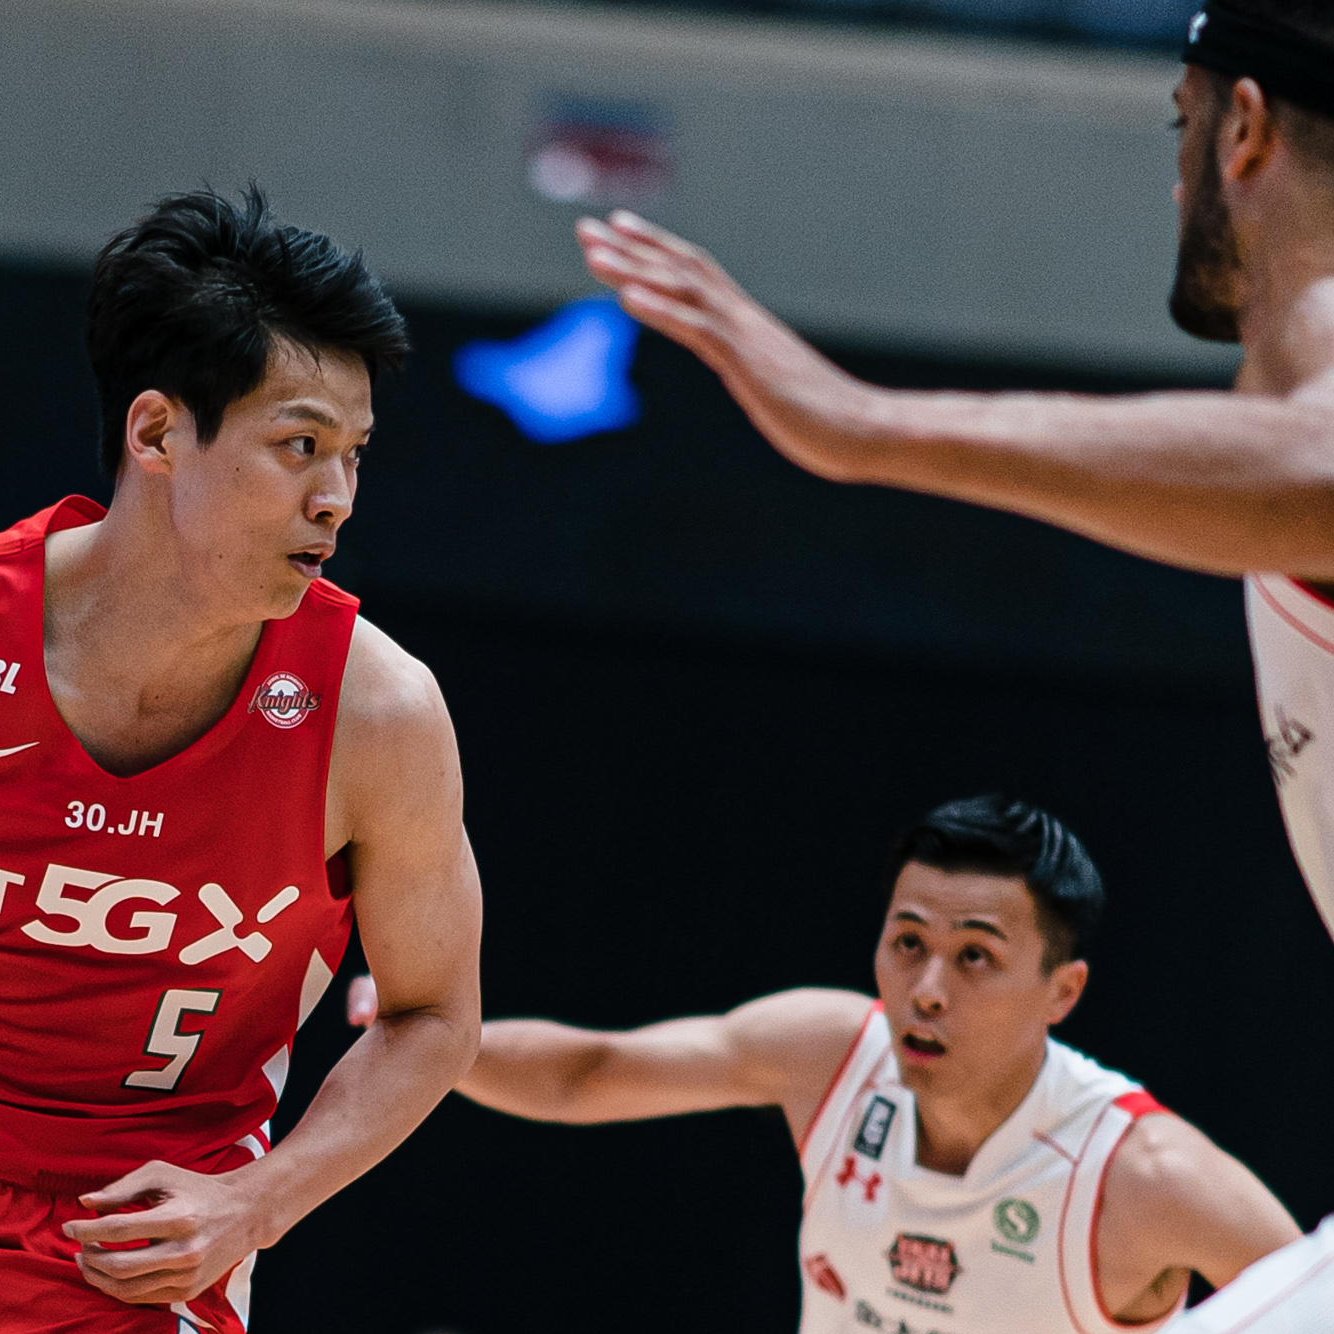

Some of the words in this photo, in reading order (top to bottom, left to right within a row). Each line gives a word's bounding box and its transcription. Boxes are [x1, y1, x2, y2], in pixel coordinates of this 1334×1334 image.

[247, 685, 321, 714] Knights
[64, 801, 164, 838] 30.JH
[121, 988, 223, 1093] 5
